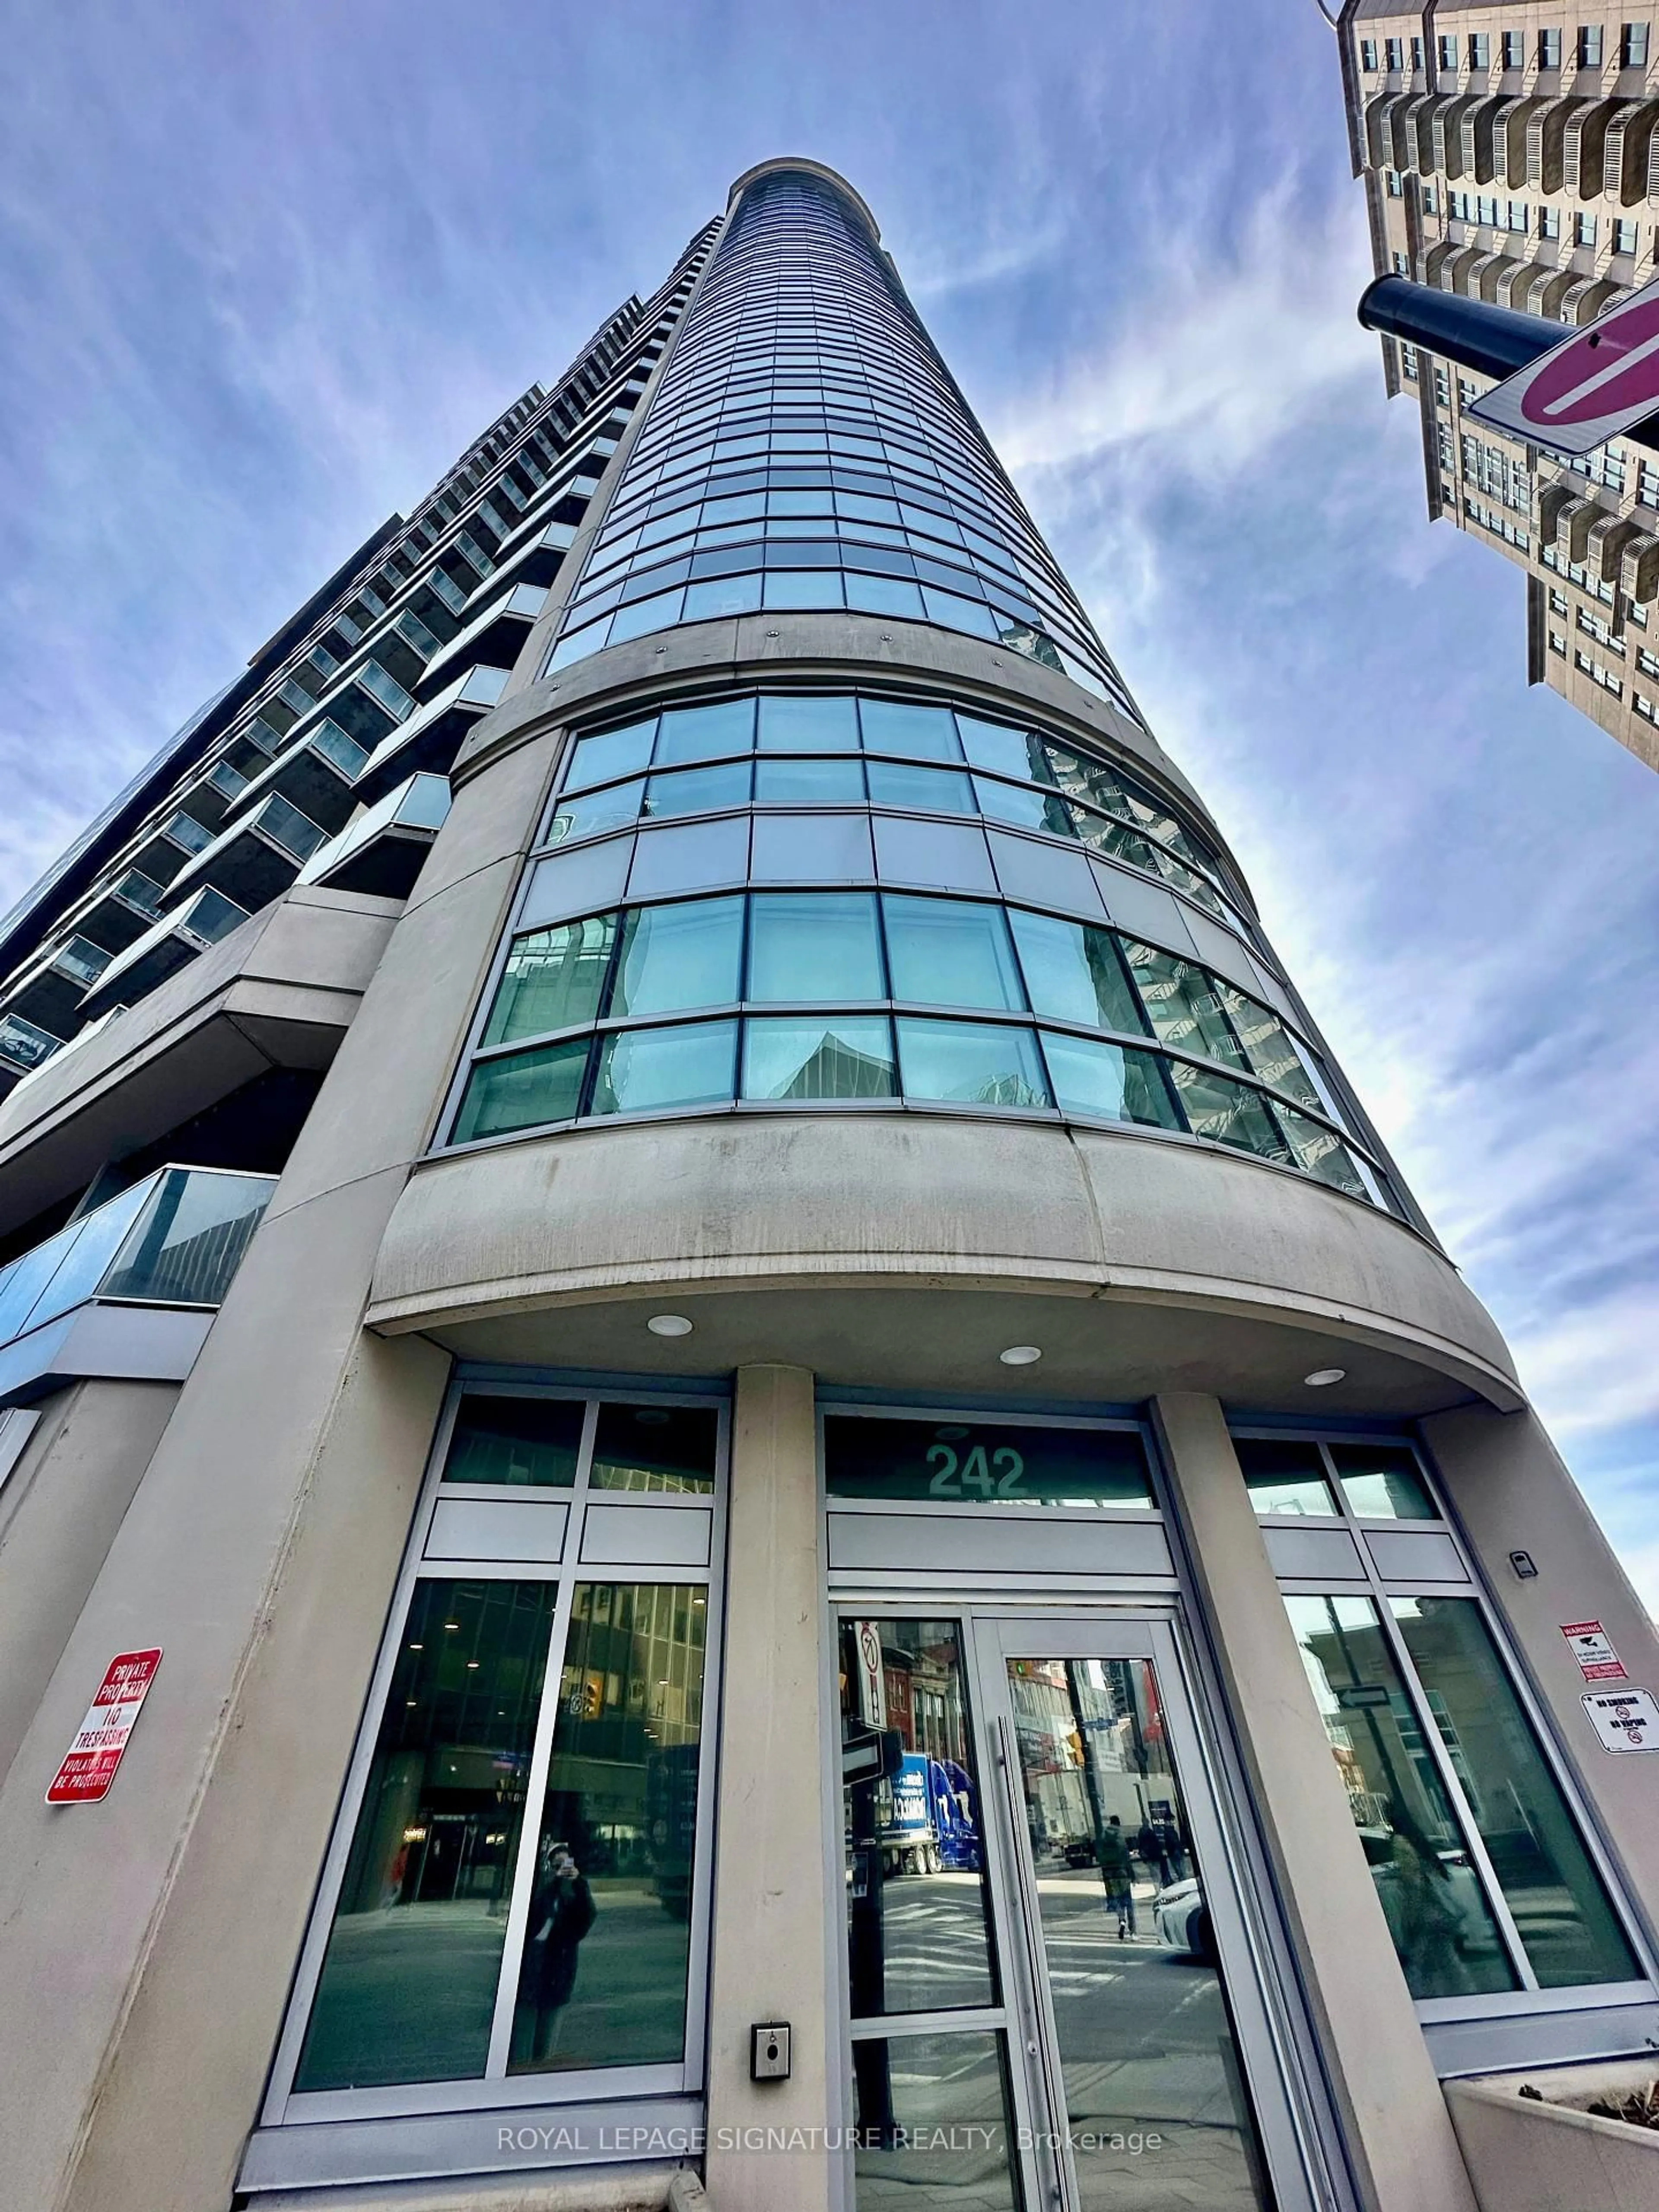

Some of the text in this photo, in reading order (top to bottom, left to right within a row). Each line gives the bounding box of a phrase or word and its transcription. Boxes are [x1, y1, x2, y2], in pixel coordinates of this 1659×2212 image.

[926, 1444, 1027, 1497] 242
[1564, 1624, 1601, 1636] WARNING
[111, 1661, 151, 1682] PRIVATE
[98, 1678, 148, 1702] PROPERTY
[1596, 1696, 1639, 1708] NO SMOKING
[103, 1707, 121, 1726] NO
[1609, 1718, 1647, 1729] NO VAPING
[76, 1727, 129, 1748] TRESPASSING
[101, 1755, 116, 1771] WILL
[54, 1775, 70, 1789] BE
